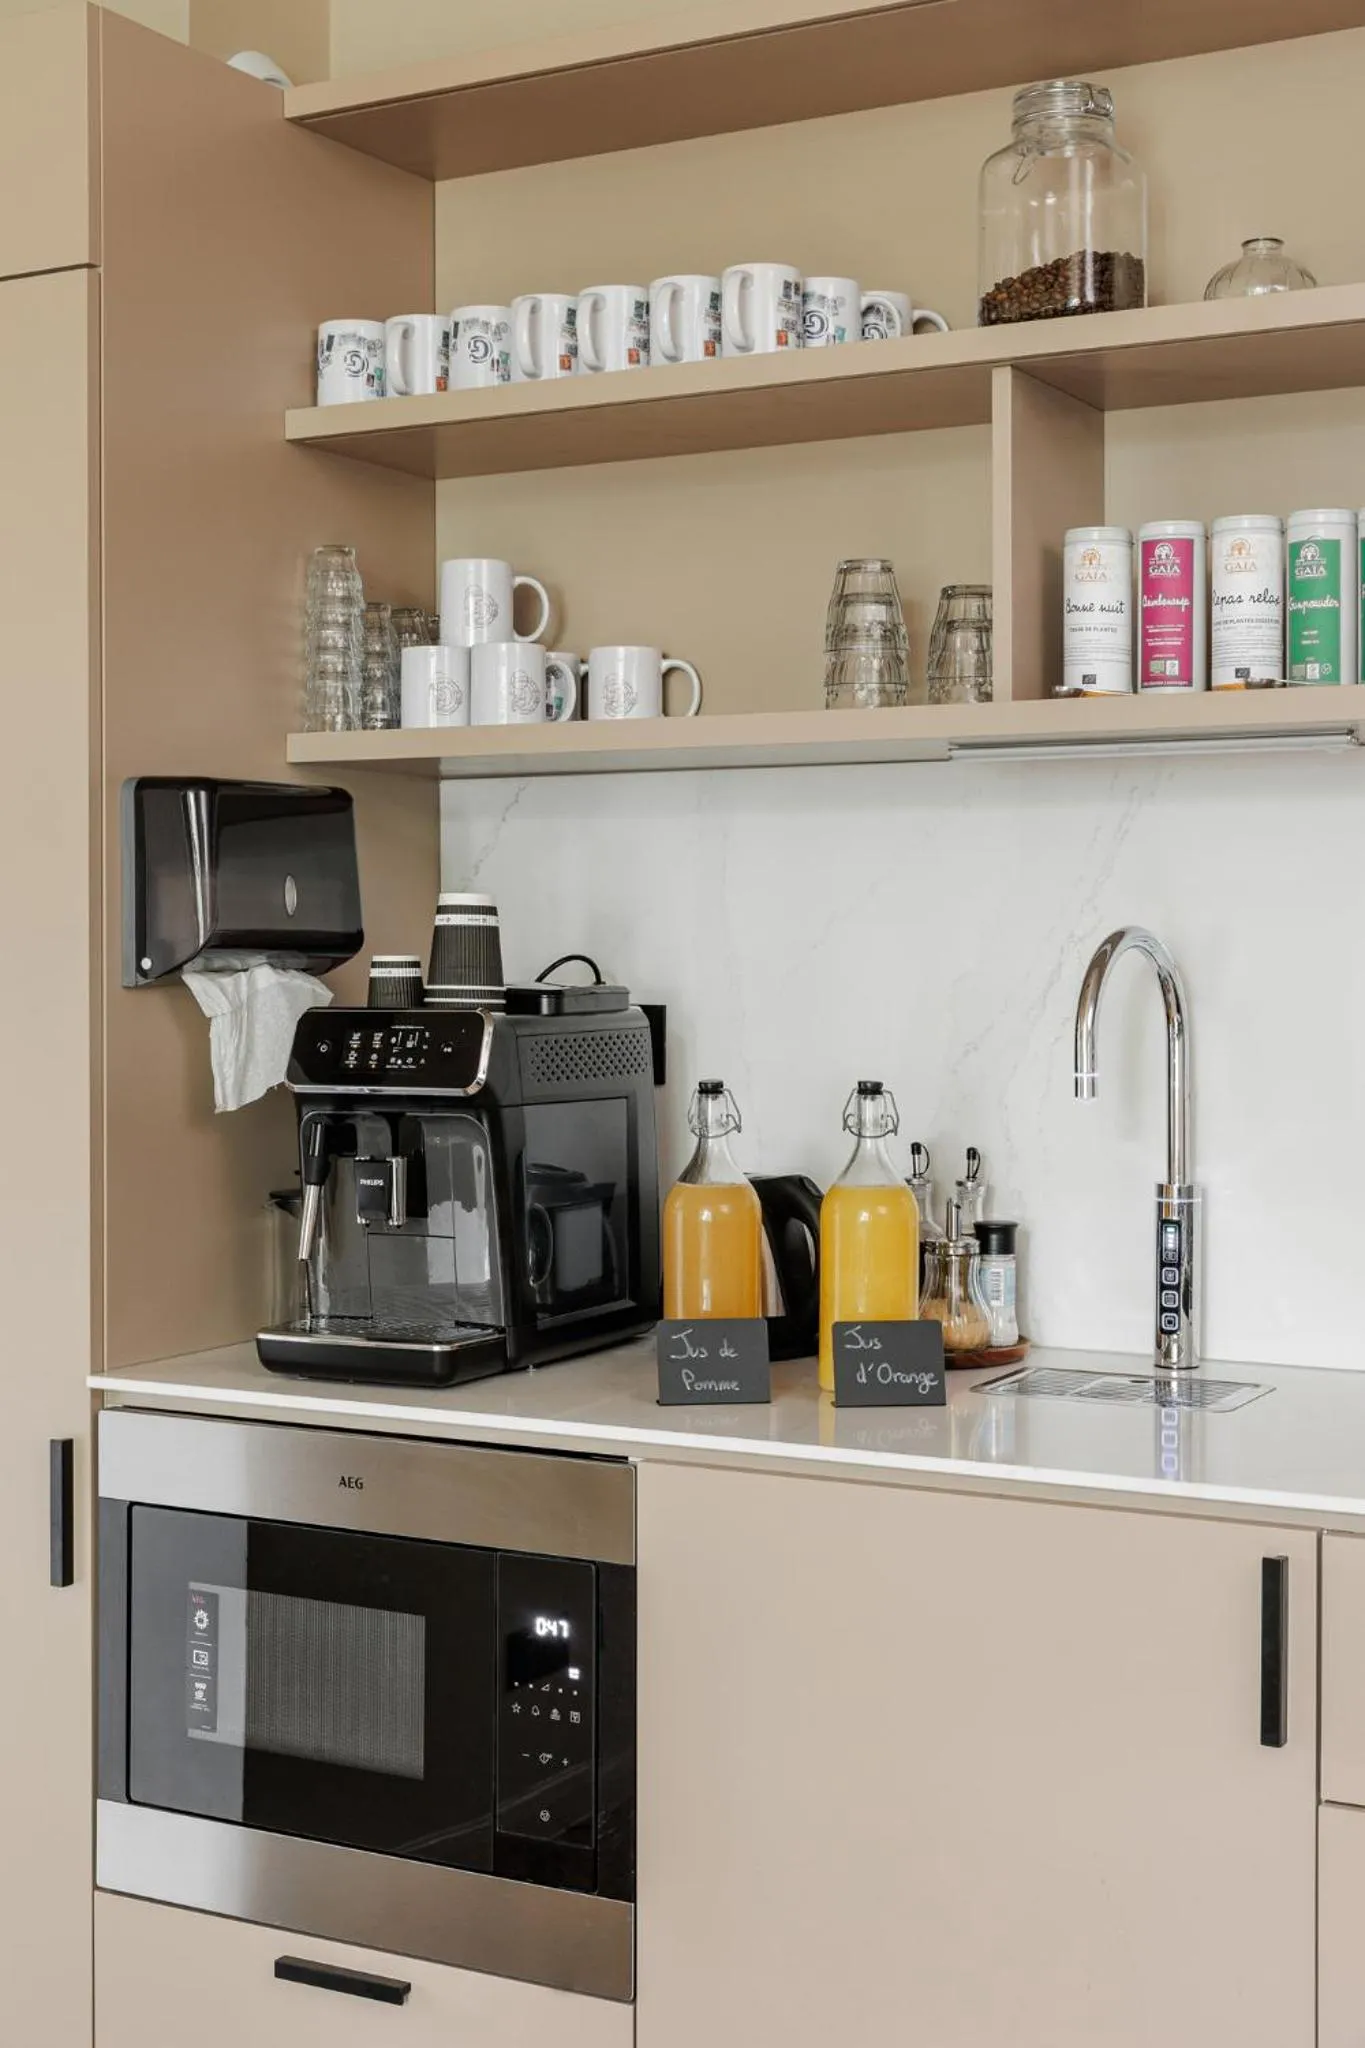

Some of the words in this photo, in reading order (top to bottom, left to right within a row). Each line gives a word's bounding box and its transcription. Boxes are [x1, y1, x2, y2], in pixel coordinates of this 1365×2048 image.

[1065, 597, 1096, 614] Bonne
[1098, 600, 1125, 614] nuit
[670, 1329, 708, 1359] Jus
[719, 1338, 739, 1358] de
[844, 1325, 882, 1350] Jus
[682, 1368, 740, 1391] Pomme
[856, 1362, 939, 1394] d'Orange
[338, 1475, 364, 1489] AEG
